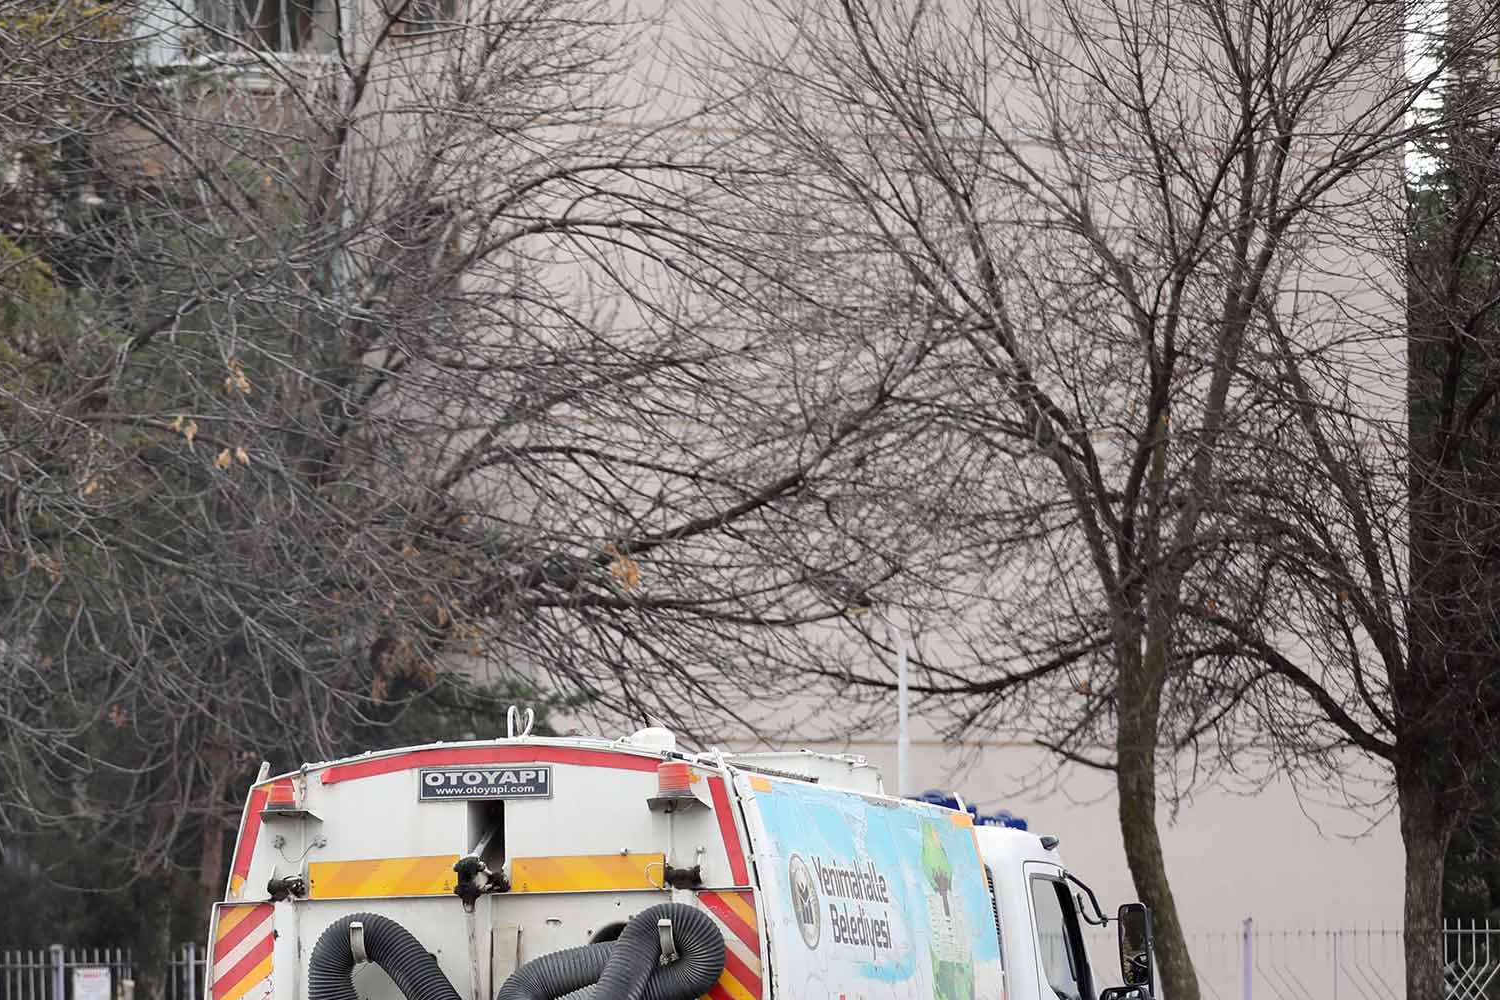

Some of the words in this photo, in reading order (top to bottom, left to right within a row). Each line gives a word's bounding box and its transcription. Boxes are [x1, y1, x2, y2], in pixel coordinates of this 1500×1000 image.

[424, 770, 546, 786] OTOYAPI
[435, 784, 535, 796] www.otoyapi.com
[811, 855, 890, 904] Yenimahalle
[829, 902, 892, 961] Belediyesi
